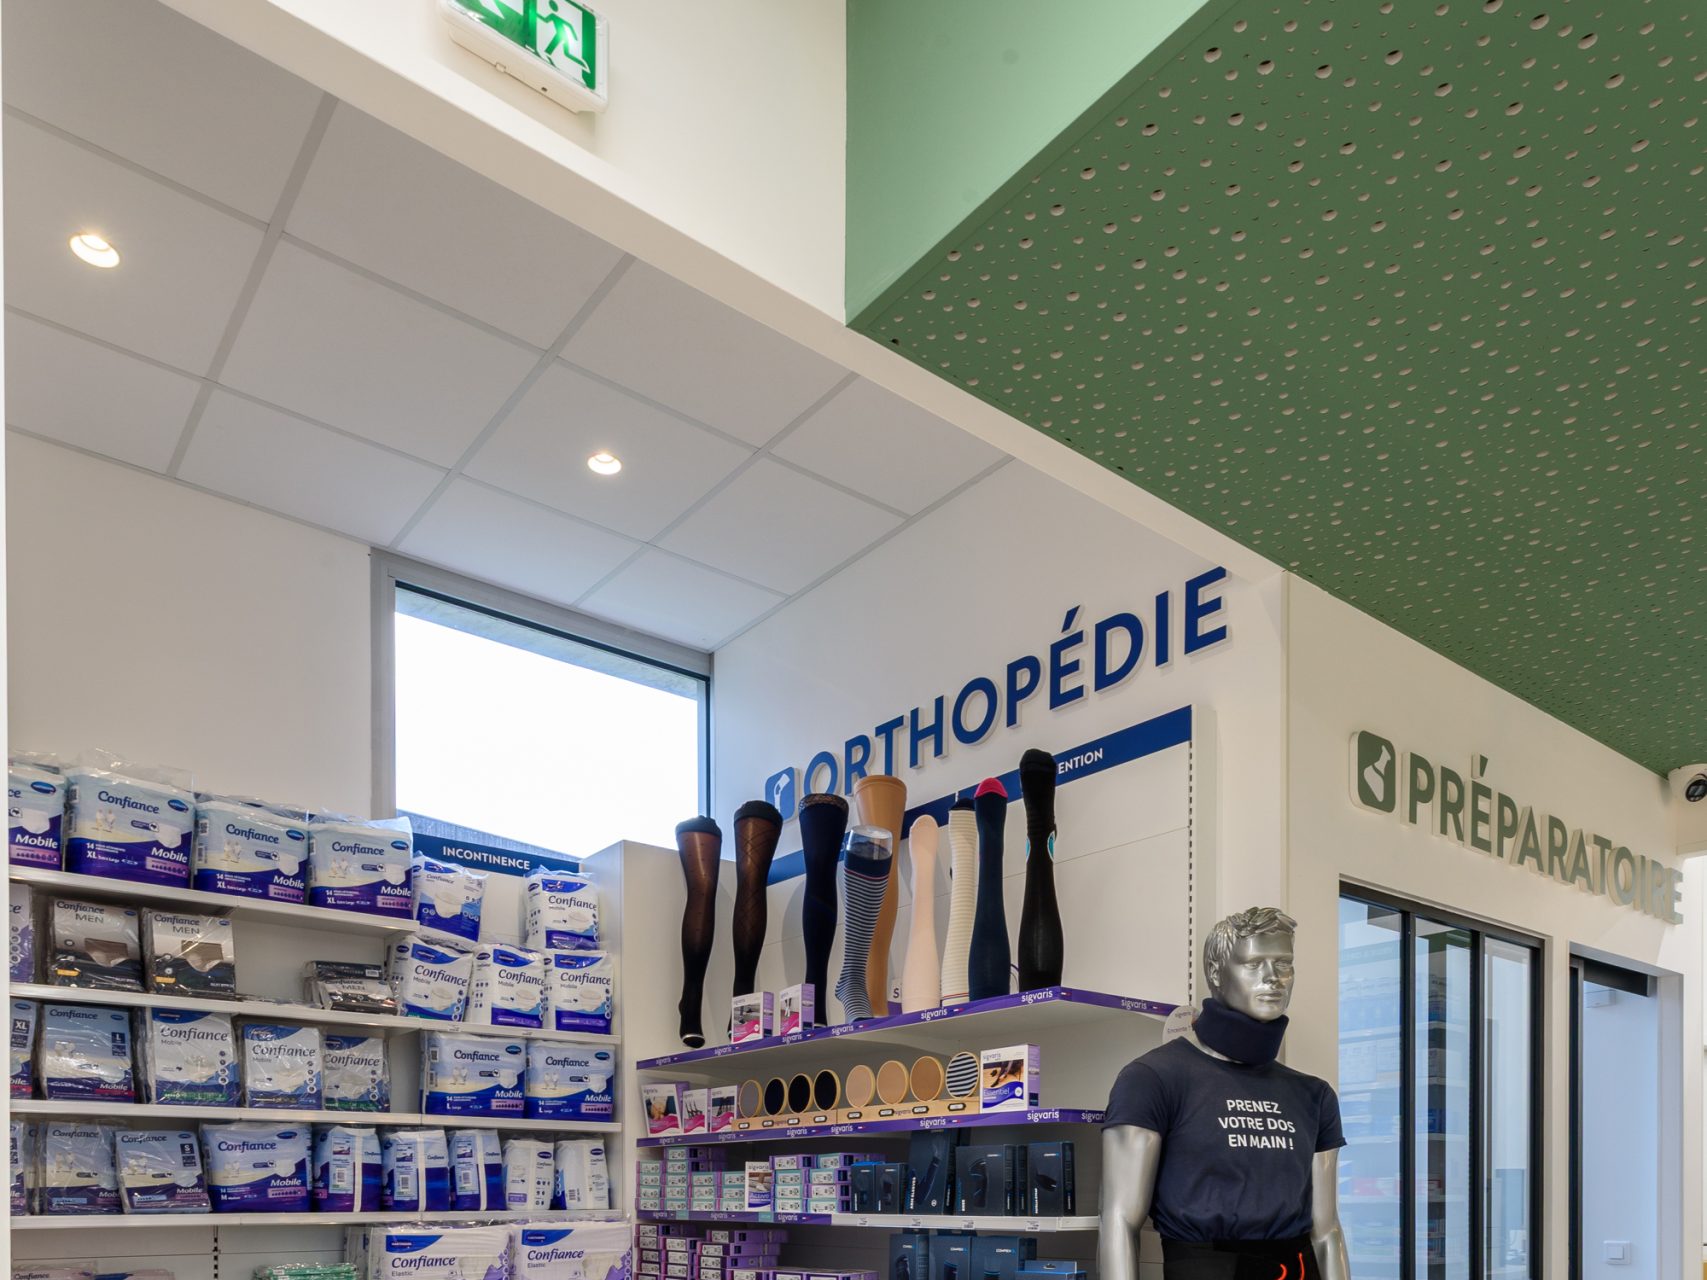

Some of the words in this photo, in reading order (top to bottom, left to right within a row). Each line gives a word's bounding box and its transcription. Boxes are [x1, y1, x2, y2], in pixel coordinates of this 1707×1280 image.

[804, 565, 1227, 798] ORTHOPÉDIE
[1058, 748, 1103, 775] ENTION
[98, 790, 160, 815] Confiance
[226, 823, 279, 845] Confiance
[1408, 752, 1683, 924] PRÉPARATOIRE
[15, 833, 58, 849] Mobile
[87, 850, 98, 859] XL
[151, 846, 188, 863] Mobile
[332, 841, 384, 857] Confiance
[443, 846, 530, 870] INCONTINENCE
[217, 881, 227, 889] XL
[273, 875, 304, 889] Mobile
[381, 885, 411, 897] Mobile
[56, 900, 105, 915] Confiance
[548, 895, 597, 911] Confiance
[75, 913, 104, 923] MEN
[154, 913, 199, 926] Confiance
[172, 925, 199, 935] MEN
[414, 964, 467, 987] Confiance
[498, 969, 545, 986] Confiance
[560, 972, 611, 986] Confiance
[1021, 989, 1053, 1003] sigvaris
[1121, 997, 1147, 1010] sigvaris
[50, 1009, 98, 1019] Confiance
[921, 1006, 948, 1020] sigvaris
[16, 1021, 27, 1029] XL
[831, 1023, 854, 1035] sigvaris
[160, 1025, 228, 1042] Confiance
[252, 1043, 316, 1059] Confiance
[454, 1050, 500, 1062] Confiance
[323, 1052, 380, 1067] Confiance
[545, 1056, 590, 1068] Confiance
[495, 1090, 523, 1098] Mobile
[584, 1094, 611, 1102] Mobile
[1226, 1099, 1282, 1114] PRENEZ
[920, 1117, 946, 1128] sigvaris
[1027, 1110, 1060, 1122] sigvaris
[1081, 1111, 1105, 1122] sigvar
[831, 1125, 853, 1134] sigvaris
[1218, 1117, 1264, 1130] VOTRE
[1267, 1118, 1296, 1133] DOS
[52, 1130, 99, 1138] Confiance
[121, 1135, 167, 1143] Confiance
[218, 1140, 277, 1152] Confiance
[1228, 1134, 1247, 1147] EN
[1250, 1136, 1286, 1149] MAIN
[1289, 1138, 1294, 1150] !
[270, 1178, 302, 1187] Mobile
[527, 1249, 584, 1262] Confiance
[392, 1256, 456, 1269] Confiance
